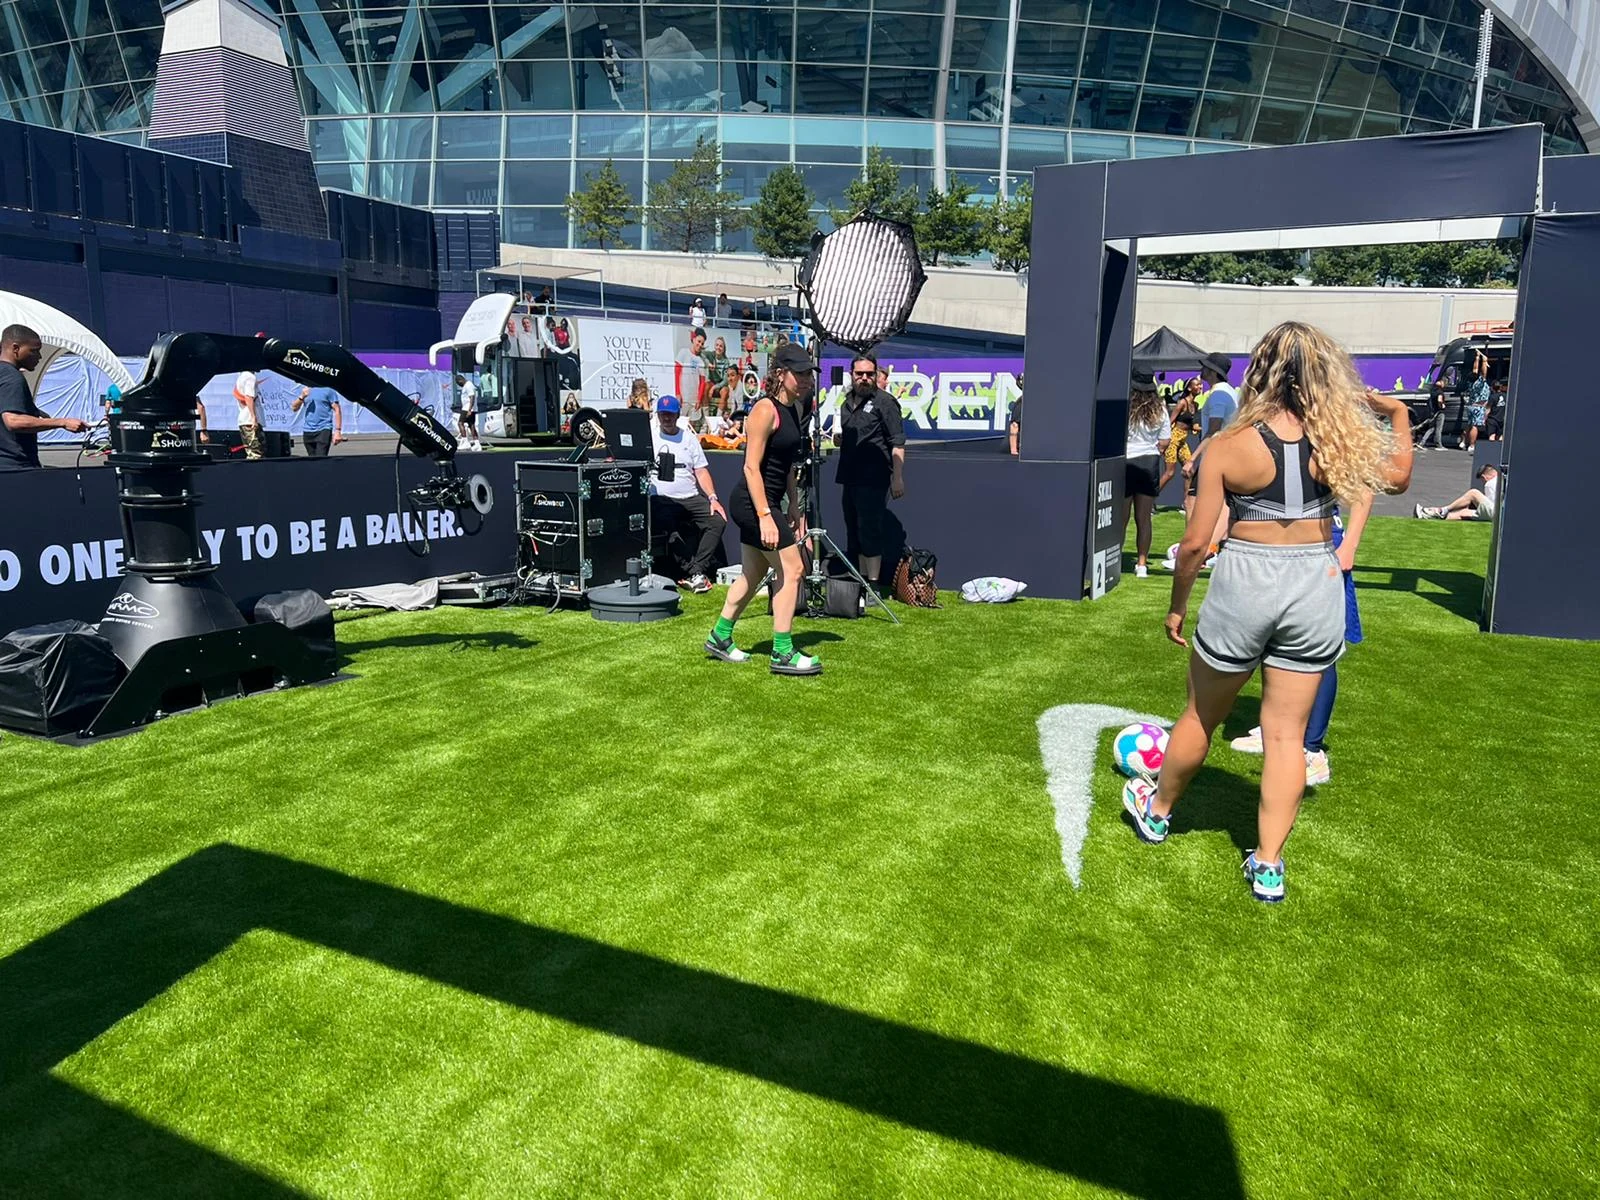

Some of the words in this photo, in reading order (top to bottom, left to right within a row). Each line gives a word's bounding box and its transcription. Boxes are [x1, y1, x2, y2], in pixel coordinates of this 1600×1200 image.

[603, 336, 651, 350] YOU'VE
[607, 349, 650, 362] NEVER
[291, 356, 340, 377] SHOWBOLT
[613, 362, 645, 375] SEEN
[417, 419, 453, 452] SHOWBOLT
[39, 538, 126, 586] ONE
[236, 523, 278, 561] TO
[289, 518, 327, 555] BE
[336, 516, 358, 550] A
